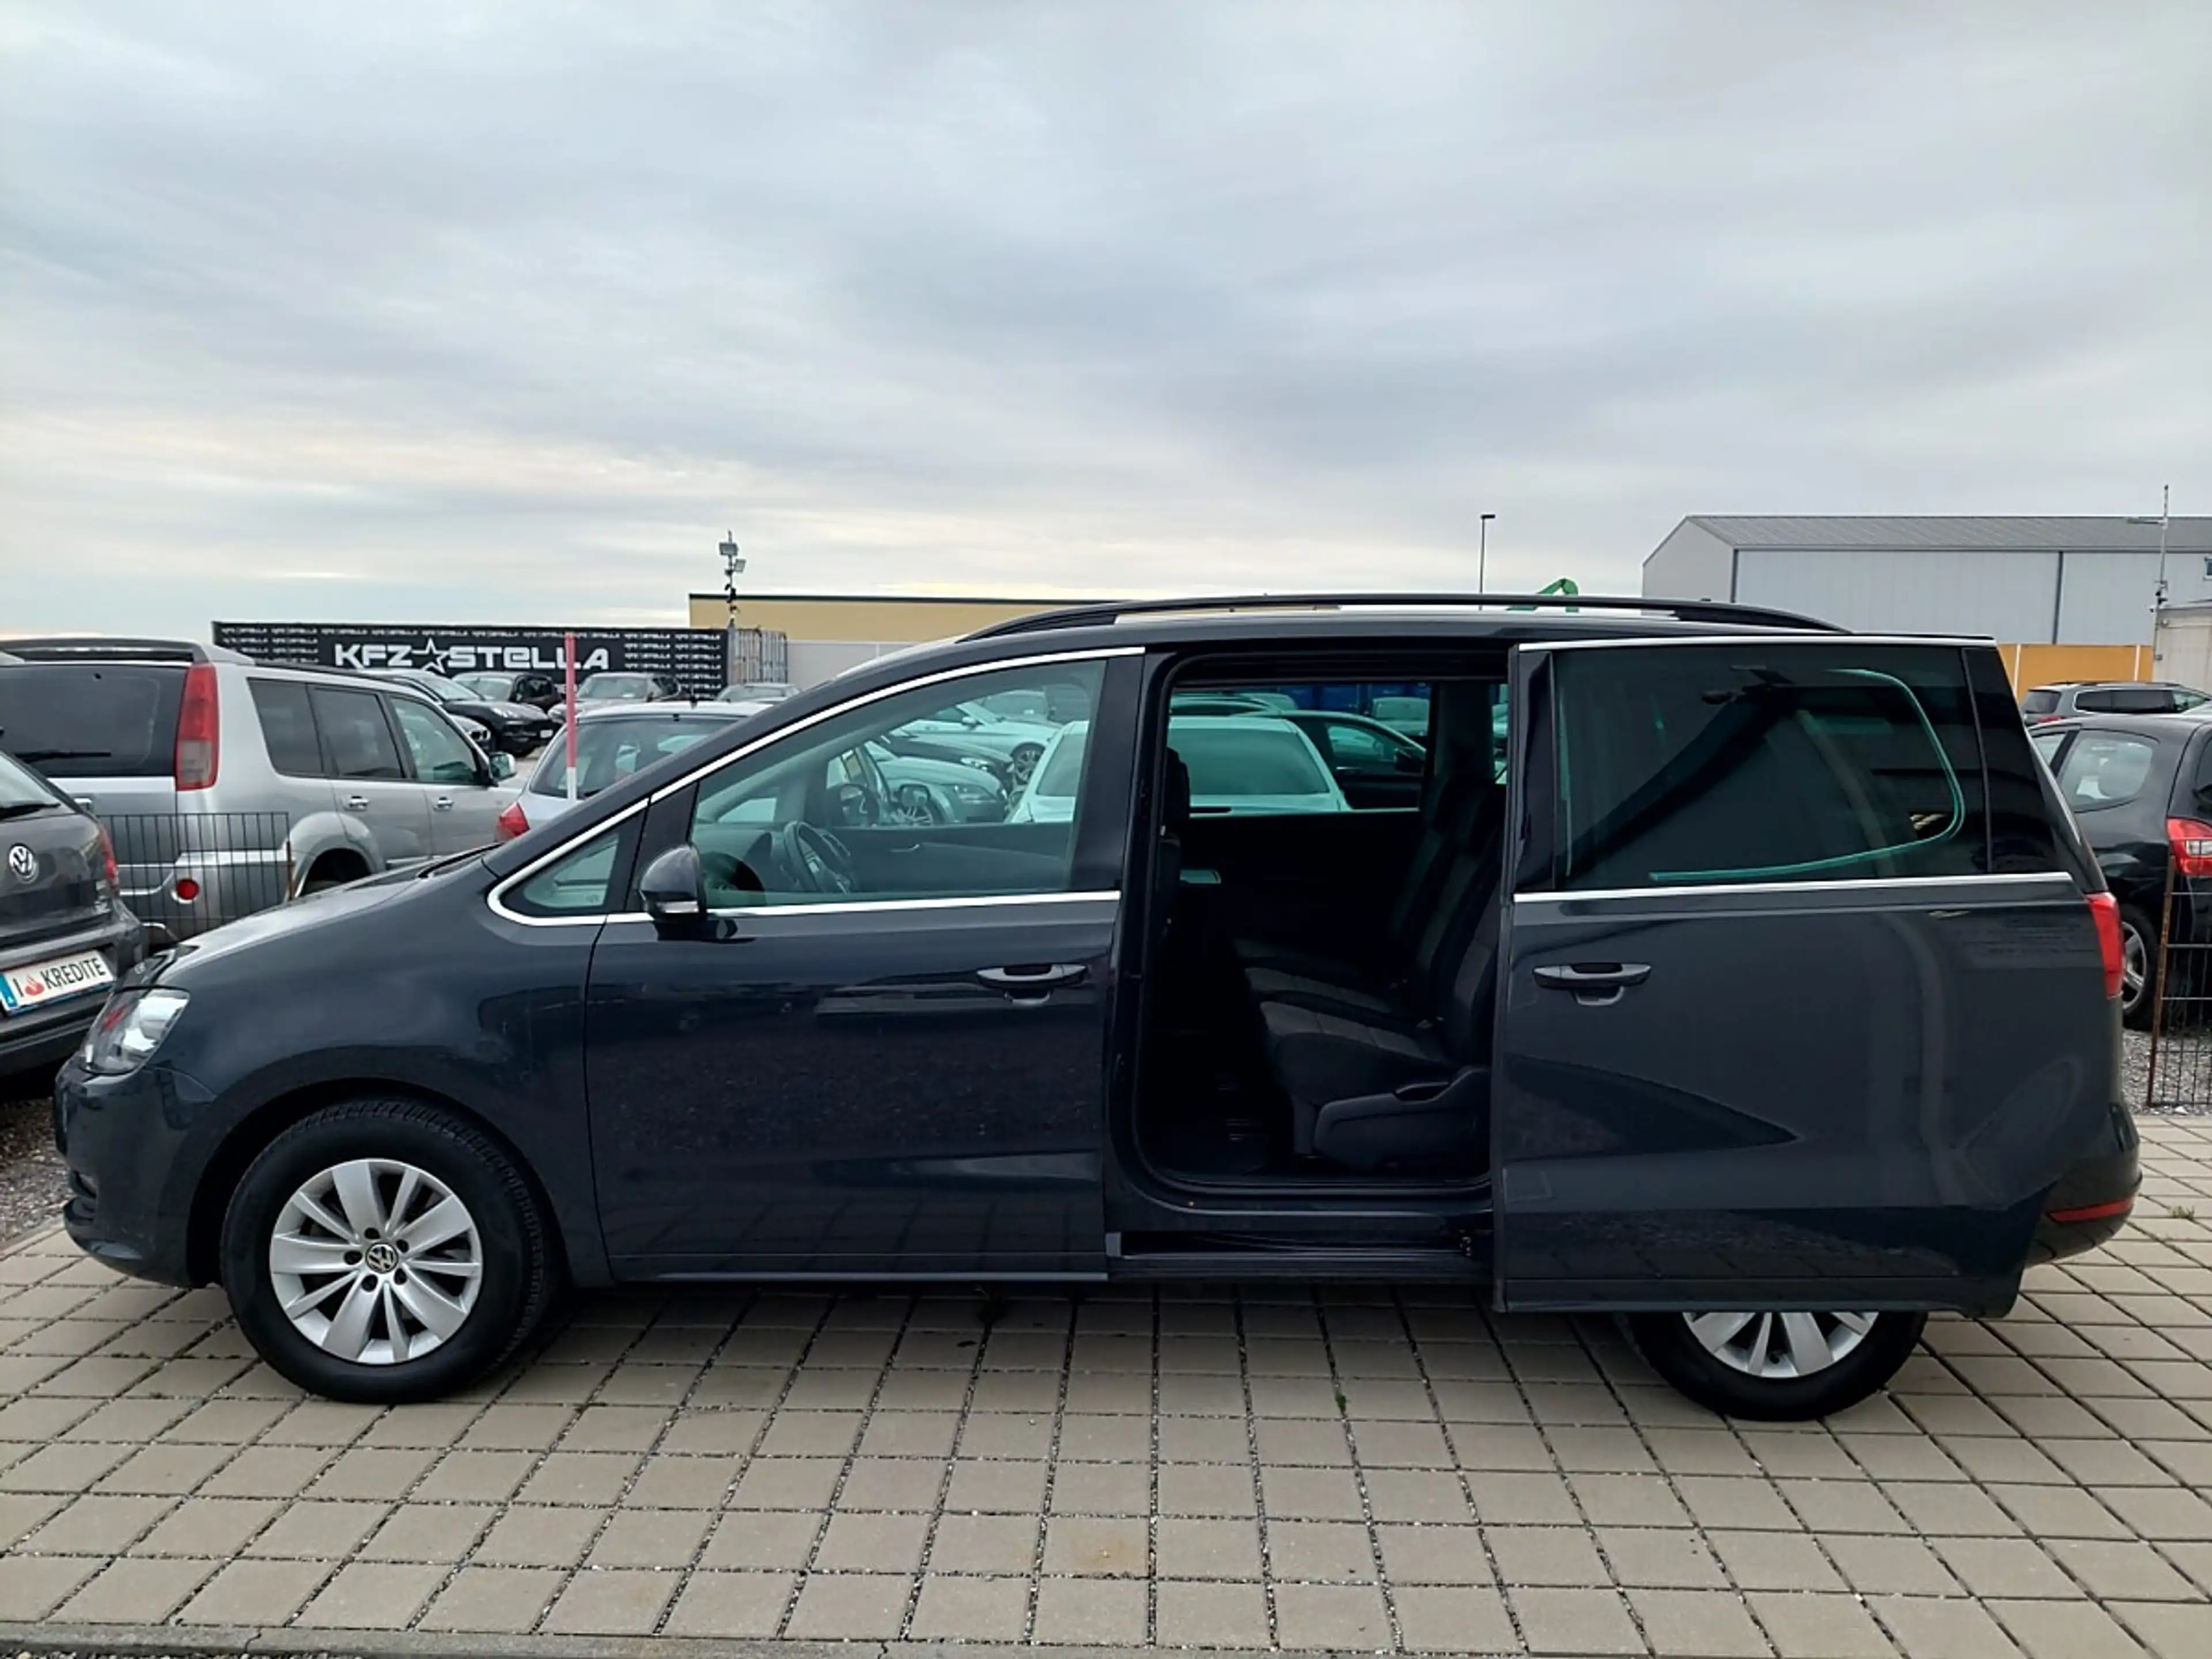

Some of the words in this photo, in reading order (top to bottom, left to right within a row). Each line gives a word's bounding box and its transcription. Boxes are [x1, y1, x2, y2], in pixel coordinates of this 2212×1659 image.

[335, 643, 413, 669] KFZ
[447, 645, 609, 670] STELLA
[12, 978, 24, 998] I
[40, 958, 106, 990] KREDITE
